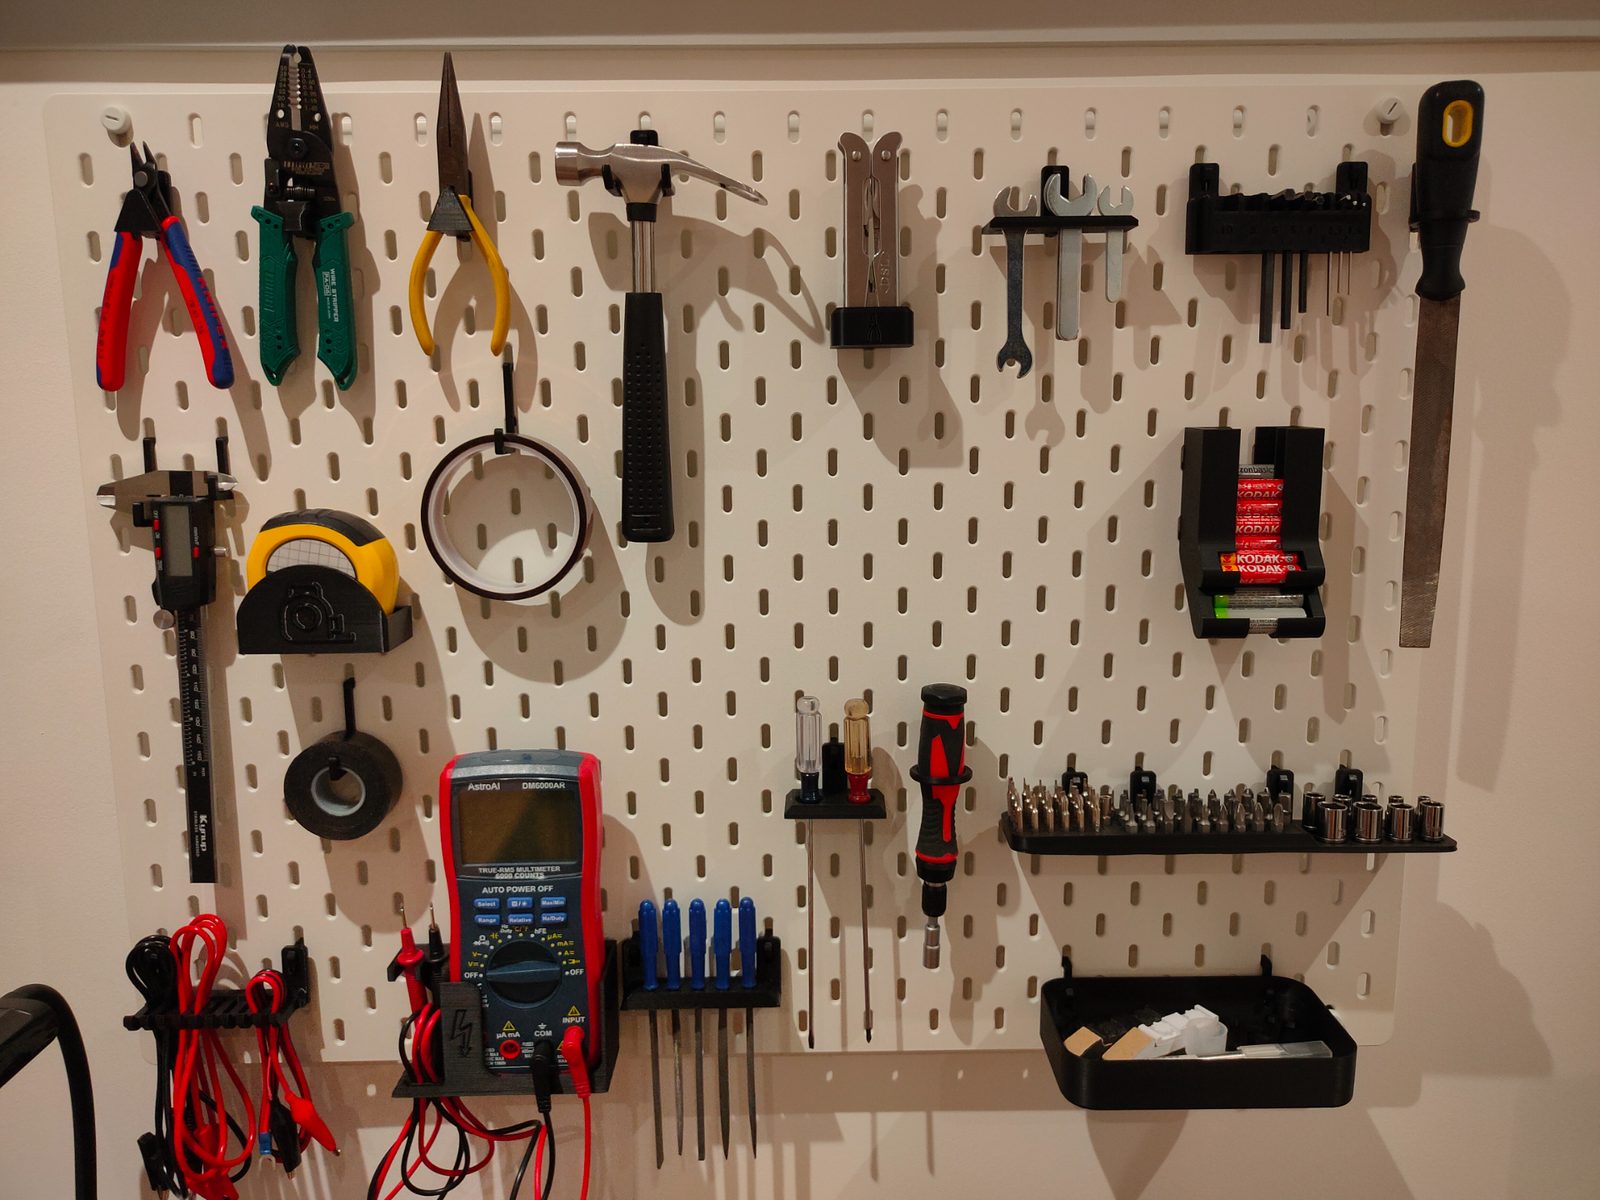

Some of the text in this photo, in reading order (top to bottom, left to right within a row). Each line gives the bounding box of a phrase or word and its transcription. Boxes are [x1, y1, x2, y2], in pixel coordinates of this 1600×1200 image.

[331, 288, 339, 322] STRIPPER
[1236, 490, 1280, 498] KODAK
[1235, 525, 1280, 534] KODAK
[1236, 554, 1280, 564] KODAK
[1239, 564, 1284, 573] KODAK
[467, 781, 566, 791] AstroAI DM6000AR
[199, 814, 208, 852] Kynup
[516, 865, 560, 873] MULTIMETER
[482, 886, 505, 894] AUTO
[506, 885, 536, 893] POWER
